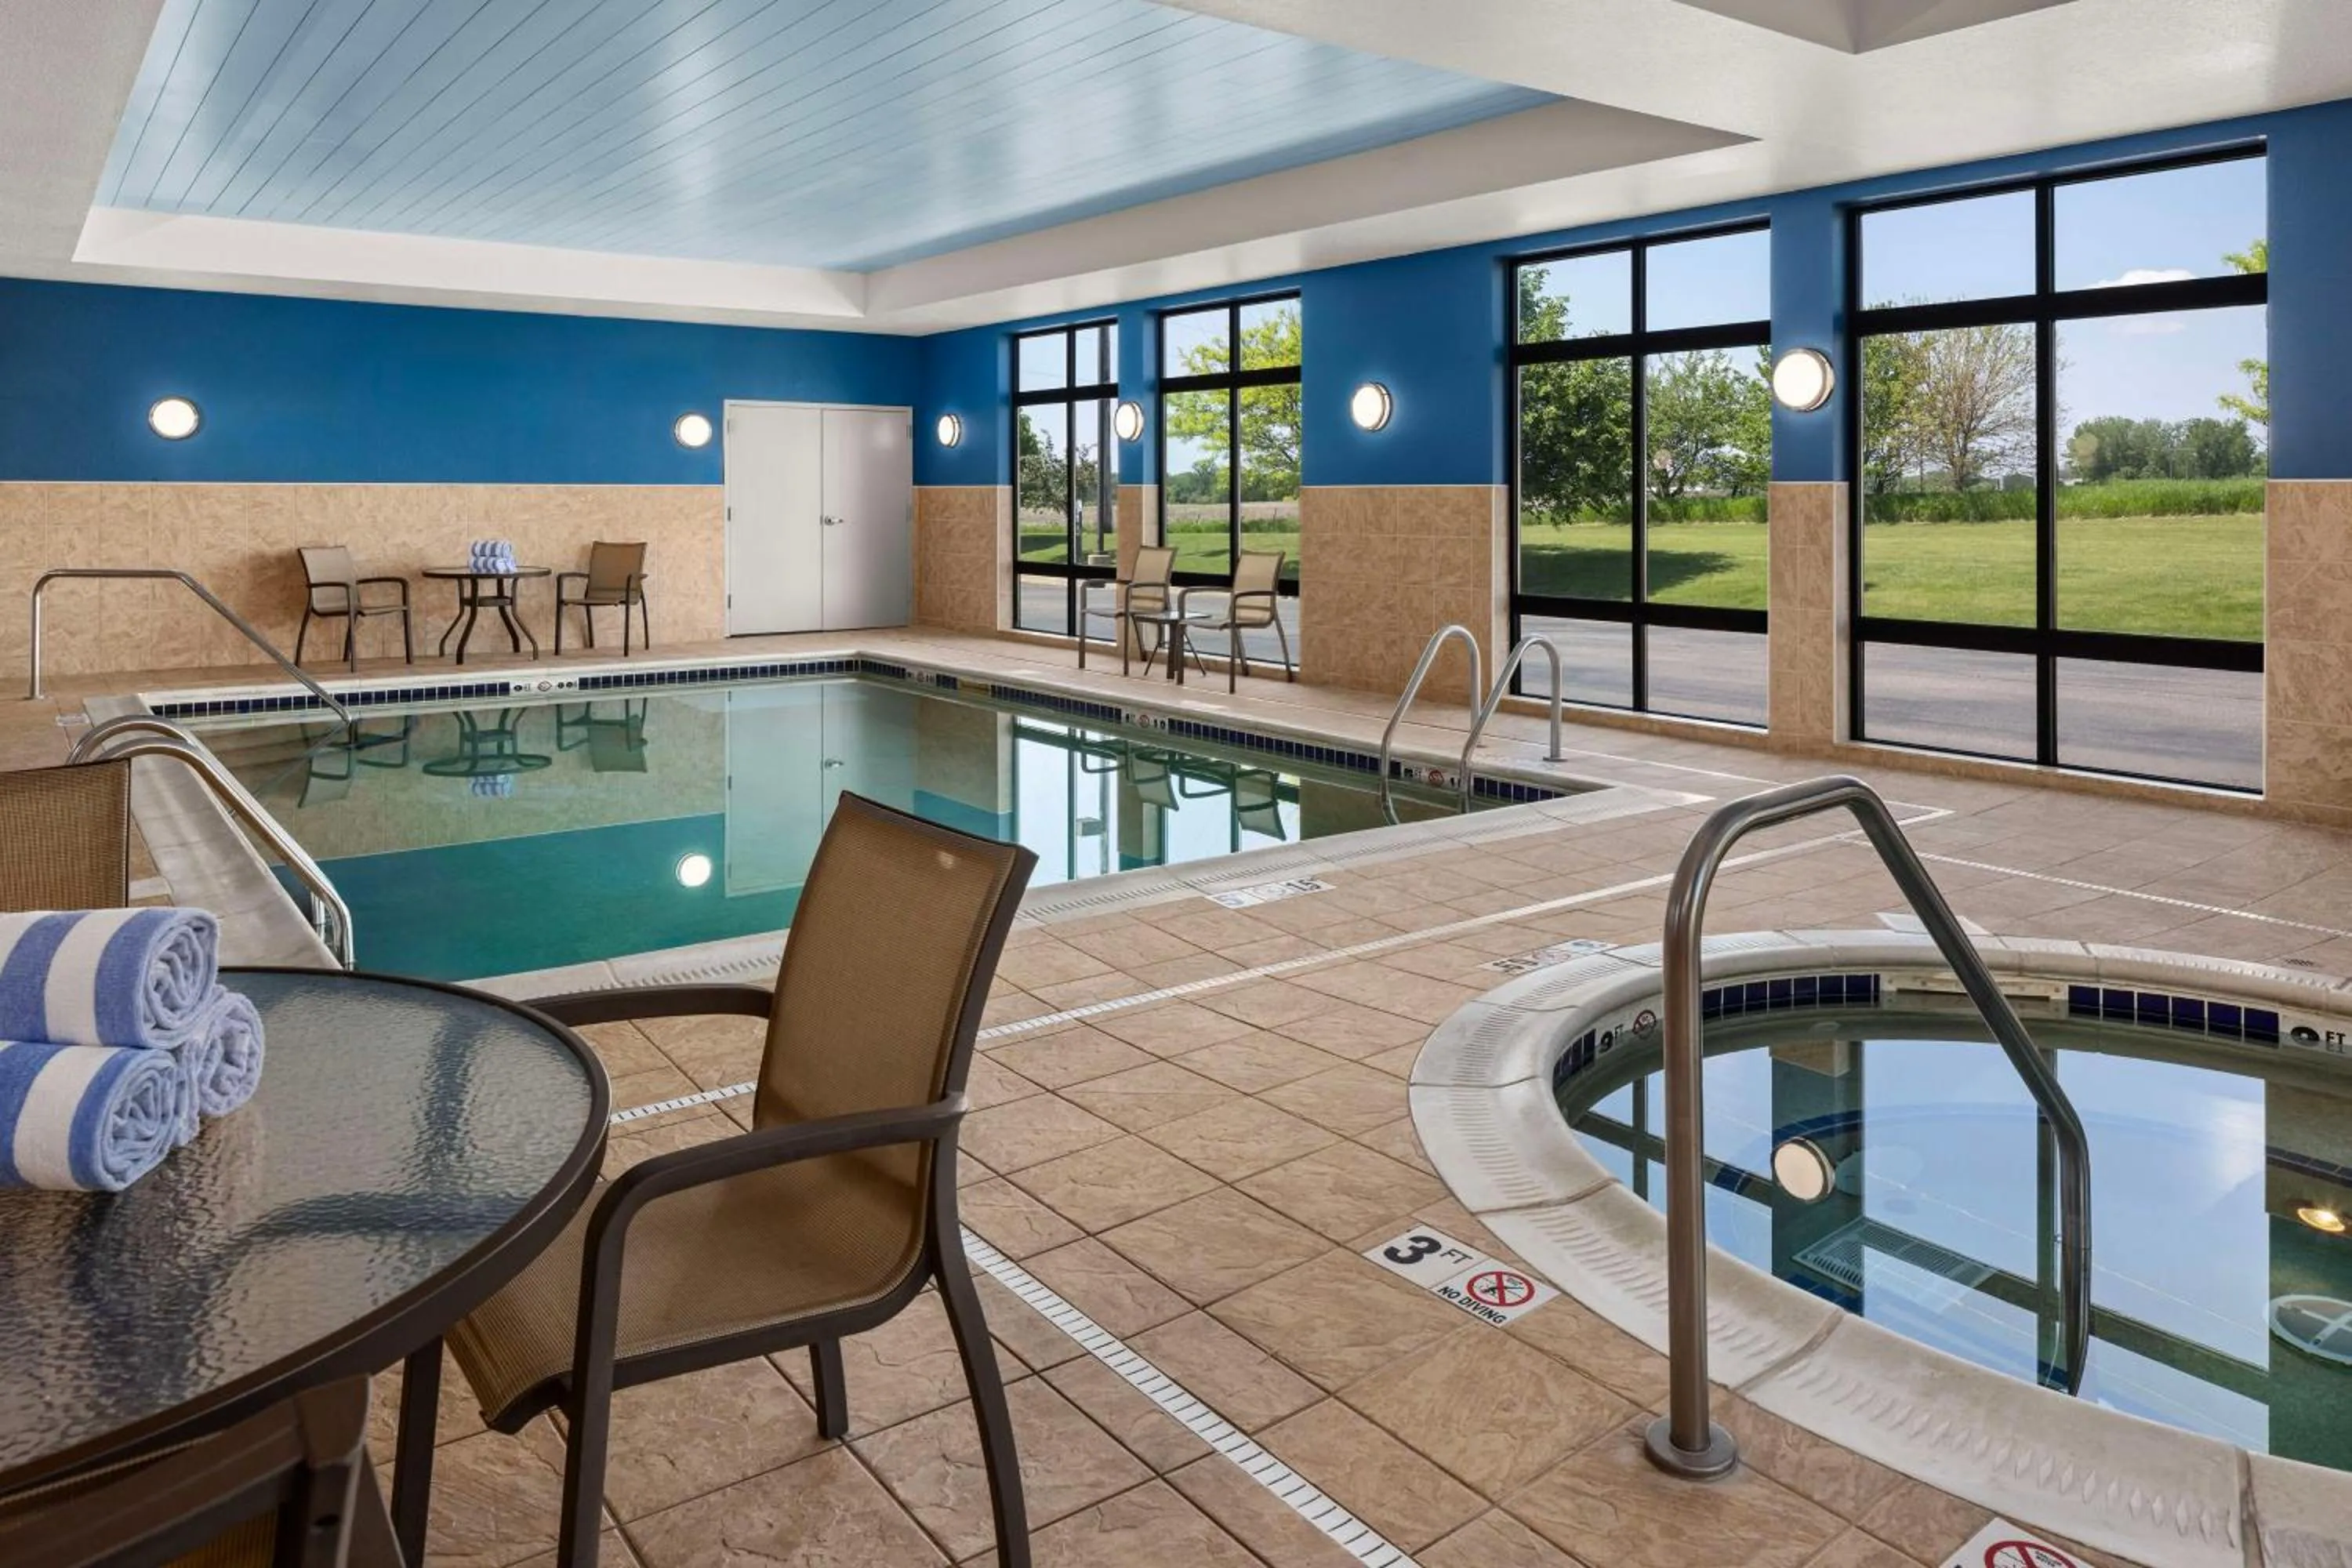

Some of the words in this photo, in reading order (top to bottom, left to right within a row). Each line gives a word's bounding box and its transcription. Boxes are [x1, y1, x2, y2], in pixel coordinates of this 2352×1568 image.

[1384, 1236, 1442, 1264] 3
[1440, 1249, 1473, 1264] FT
[1438, 1286, 1461, 1299] NO
[1458, 1296, 1507, 1323] DIVING
